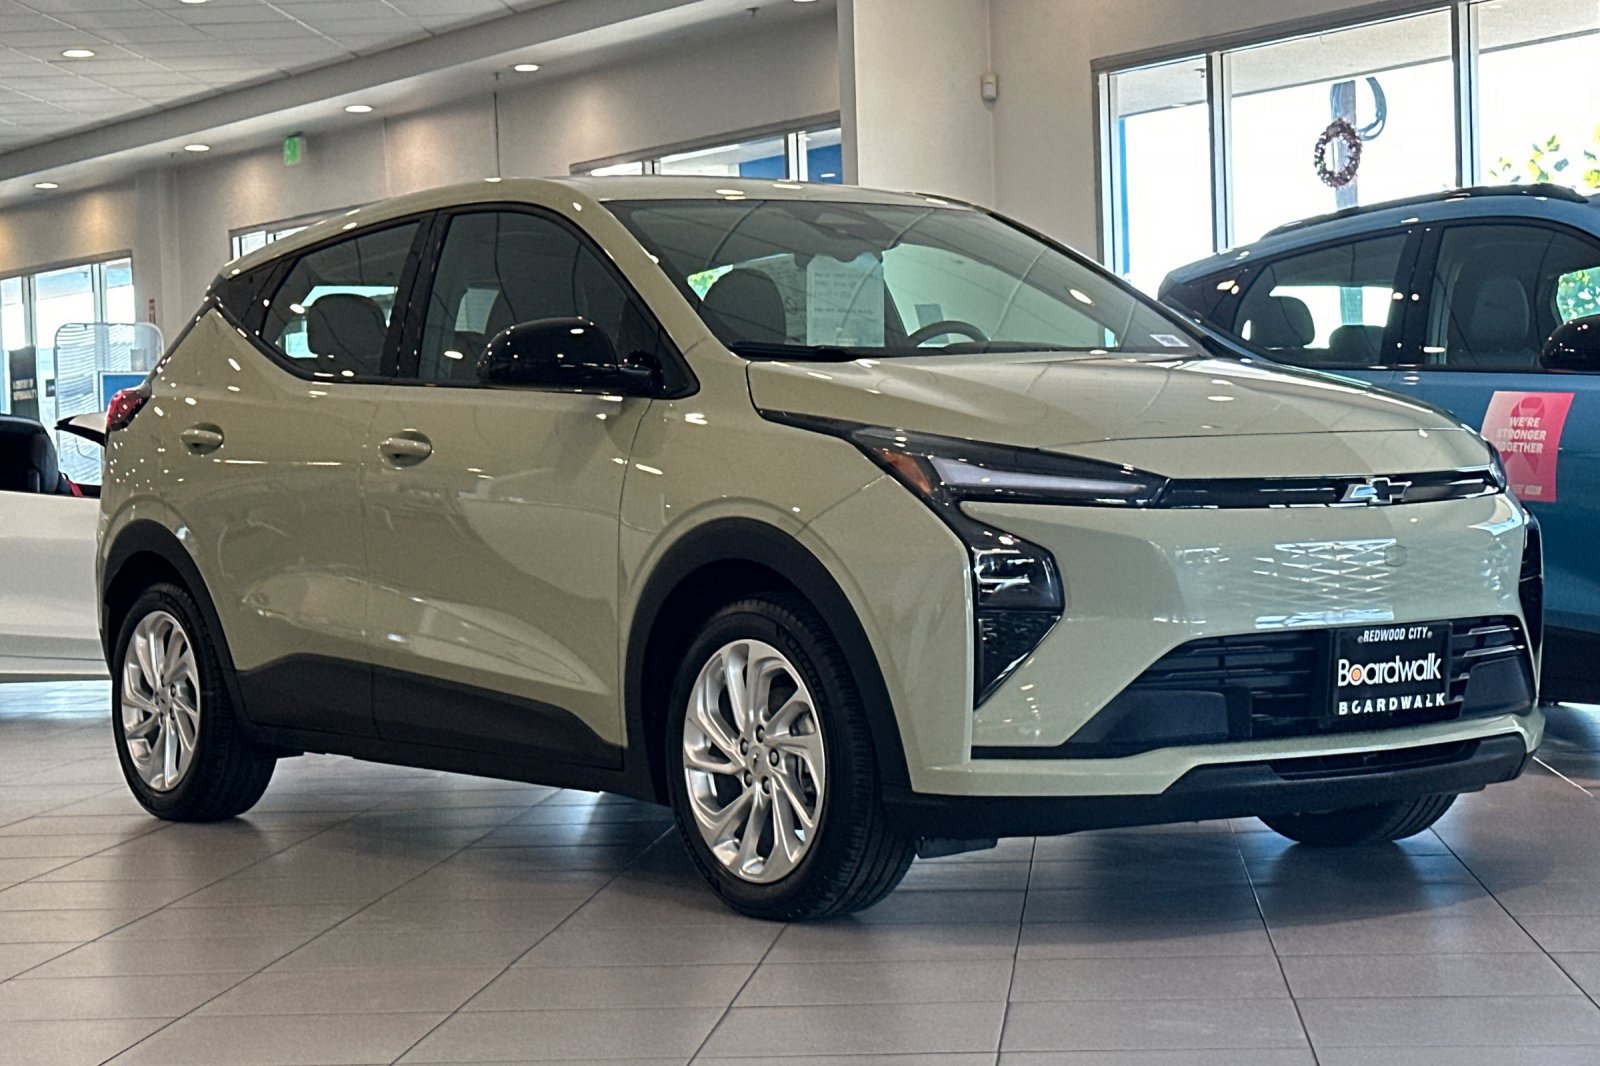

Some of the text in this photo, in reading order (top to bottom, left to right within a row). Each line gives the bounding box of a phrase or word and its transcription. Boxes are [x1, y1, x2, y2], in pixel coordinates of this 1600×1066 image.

[1509, 416, 1541, 428] WE'RE
[1496, 428, 1547, 441] STRONGER
[1363, 627, 1428, 642] REDWOOD CITY
[1337, 652, 1442, 687] Boardwalk
[1338, 693, 1446, 715] BOARDWALK
